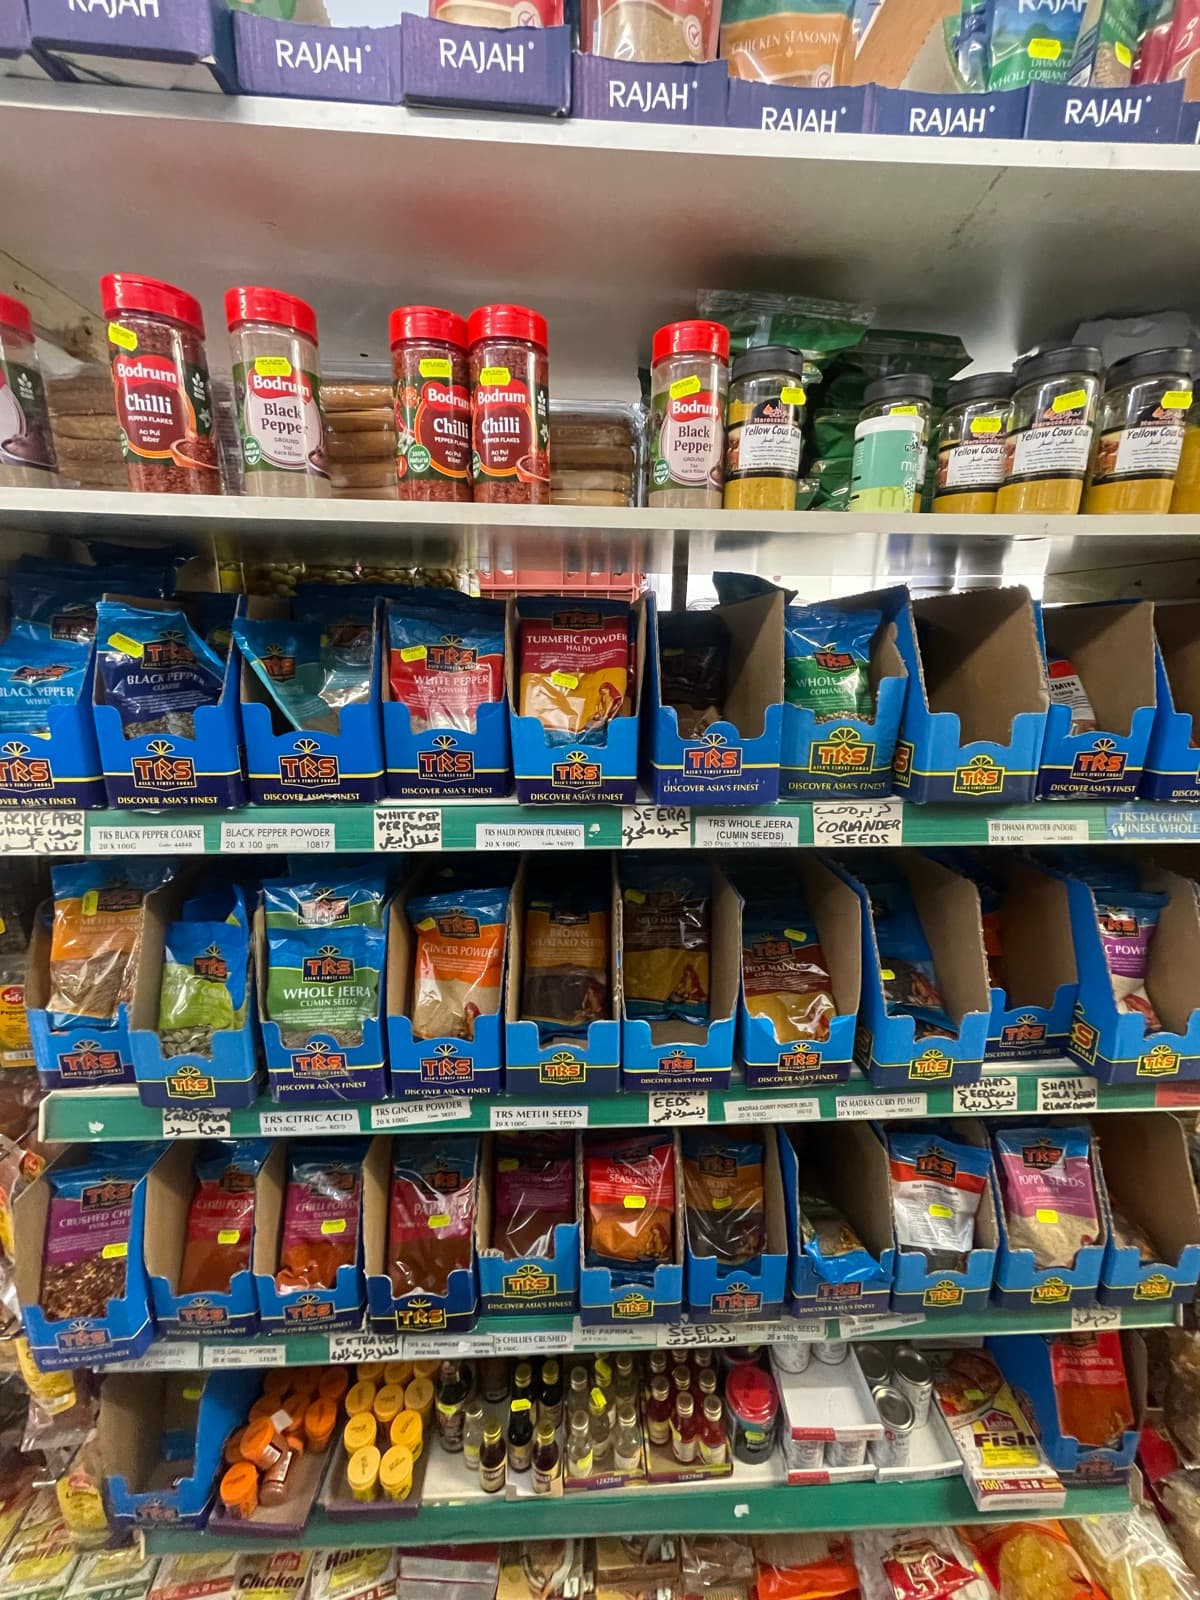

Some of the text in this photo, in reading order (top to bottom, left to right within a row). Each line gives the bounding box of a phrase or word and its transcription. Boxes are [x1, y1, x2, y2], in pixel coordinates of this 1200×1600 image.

[275, 39, 363, 74] RAJAH
[438, 38, 525, 73] RAJAH
[609, 80, 688, 112] RAJAH
[761, 107, 837, 133] RAJAH
[1065, 98, 1142, 127] RAJAH
[908, 107, 985, 135] RAJAH
[117, 363, 177, 384] Bodrum
[253, 374, 310, 397] Bodrum
[125, 393, 173, 414] Chilli
[477, 389, 526, 405] Bodrum
[264, 402, 302, 420] Black
[672, 400, 719, 417] Bodrum
[433, 417, 469, 440] Chilli
[482, 416, 520, 435] Chilli
[678, 425, 710, 439] Black
[744, 425, 789, 437] Yellow Cous
[1021, 428, 1049, 443] Yellow
[1052, 427, 1073, 438] Cous
[1126, 427, 1177, 441] Yellow Cous
[673, 439, 712, 453] Pepper
[953, 444, 1001, 458] Yellow Cous
[527, 632, 627, 645] TURMERIC POWDER
[430, 648, 474, 663] TRS
[566, 644, 591, 652] HALDI
[815, 653, 853, 669] TRS
[127, 673, 164, 686] BLACK
[453, 673, 489, 685] PEPPER
[37, 686, 75, 698] PEPPER
[689, 748, 738, 769] TRS
[818, 743, 868, 765] TRS
[1078, 751, 1124, 772] TRS
[135, 758, 187, 781] TRS
[282, 756, 336, 778] TRS
[420, 752, 473, 773] TRS
[556, 763, 598, 781] TRS
[961, 768, 999, 785] TRS
[402, 786, 493, 795] DISCOVER ASIA'S FINEST
[663, 783, 760, 793] DISCOVER ASIA'S FINEST
[788, 781, 885, 791] DISCOVER ASIA'S FINEST
[1050, 783, 1136, 793] DISCOVER ASIA'S FINEST
[21, 796, 77, 805] ASIA'S FINEST
[117, 796, 218, 805] DISCOVER ASIA'S FINEST
[263, 793, 303, 801] DISCOVER
[530, 792, 624, 801] DISCOVER ASIA'S FINEST
[376, 812, 440, 822] WHITE PEP
[1119, 811, 1137, 822] TRS
[378, 821, 441, 836] PER POWDER
[708, 819, 793, 830] TRS WHOLE JEERA
[816, 819, 900, 833] CORIANDER
[99, 829, 202, 840] TRS BLACK PEPPER COARSE
[226, 828, 330, 838] BLACK PEPPER POWDER
[484, 827, 581, 838] TRS HALDI POWDER (TURMERIC)
[716, 831, 784, 841] (CUMIN SEEDS)
[831, 833, 889, 845] SEEDS
[225, 841, 236, 849] 20
[239, 841, 245, 849] X
[248, 841, 263, 849] 100
[306, 840, 330, 849] 10817
[439, 916, 479, 934] TRS
[422, 942, 499, 958] GINGER POWDER
[307, 957, 351, 975] TRS
[744, 963, 766, 975] HOT
[283, 985, 371, 1000] WHOLE JEERA
[300, 999, 358, 1008] CUMIN SEEDS
[1004, 1025, 1043, 1042] TRS
[62, 1051, 116, 1071] TRS
[295, 1052, 342, 1072] TRS
[661, 1058, 694, 1071] TRS
[782, 1051, 817, 1067] TRS
[1144, 1053, 1175, 1069] TRS
[422, 1058, 470, 1077] TRS
[545, 1063, 581, 1078] TRS
[915, 1061, 948, 1075] TRS
[171, 1077, 209, 1092] TRS
[640, 1077, 672, 1085] DISCOVER
[758, 1073, 838, 1084] DISCOVER ASIA'S FINEST
[276, 1081, 367, 1092] DISCOVER ASIA'S FINEST
[404, 1087, 491, 1096] DISCOVER ASIA'S FINEST
[375, 1101, 462, 1117] TRS GINGER POWDER
[837, 1097, 920, 1109] TRS MADRAS CURRY PD HOT
[264, 1113, 353, 1124] TRS CITRIC ACID
[392, 1117, 409, 1125] 100G
[495, 1111, 514, 1119] TRS
[552, 1109, 582, 1118] SEEDS
[1025, 1148, 1061, 1165] TRS
[918, 1158, 956, 1174] TRS
[86, 1183, 132, 1203] TRS
[59, 1212, 110, 1229] CRUSHED
[509, 1276, 548, 1290] TRS
[820, 1284, 860, 1297] TRS
[487, 1301, 572, 1310] DISCOVER ASIA'S FINEST
[618, 1302, 648, 1313] TRS
[715, 1295, 759, 1309] TRS
[183, 1309, 224, 1323] TRS
[287, 1303, 331, 1318] TRS
[399, 1309, 444, 1325] TRS
[59, 1330, 105, 1348] TRS
[667, 1325, 730, 1338] SEEDS
[973, 1432, 1035, 1448] Fish
[239, 1573, 304, 1589] Chicken
